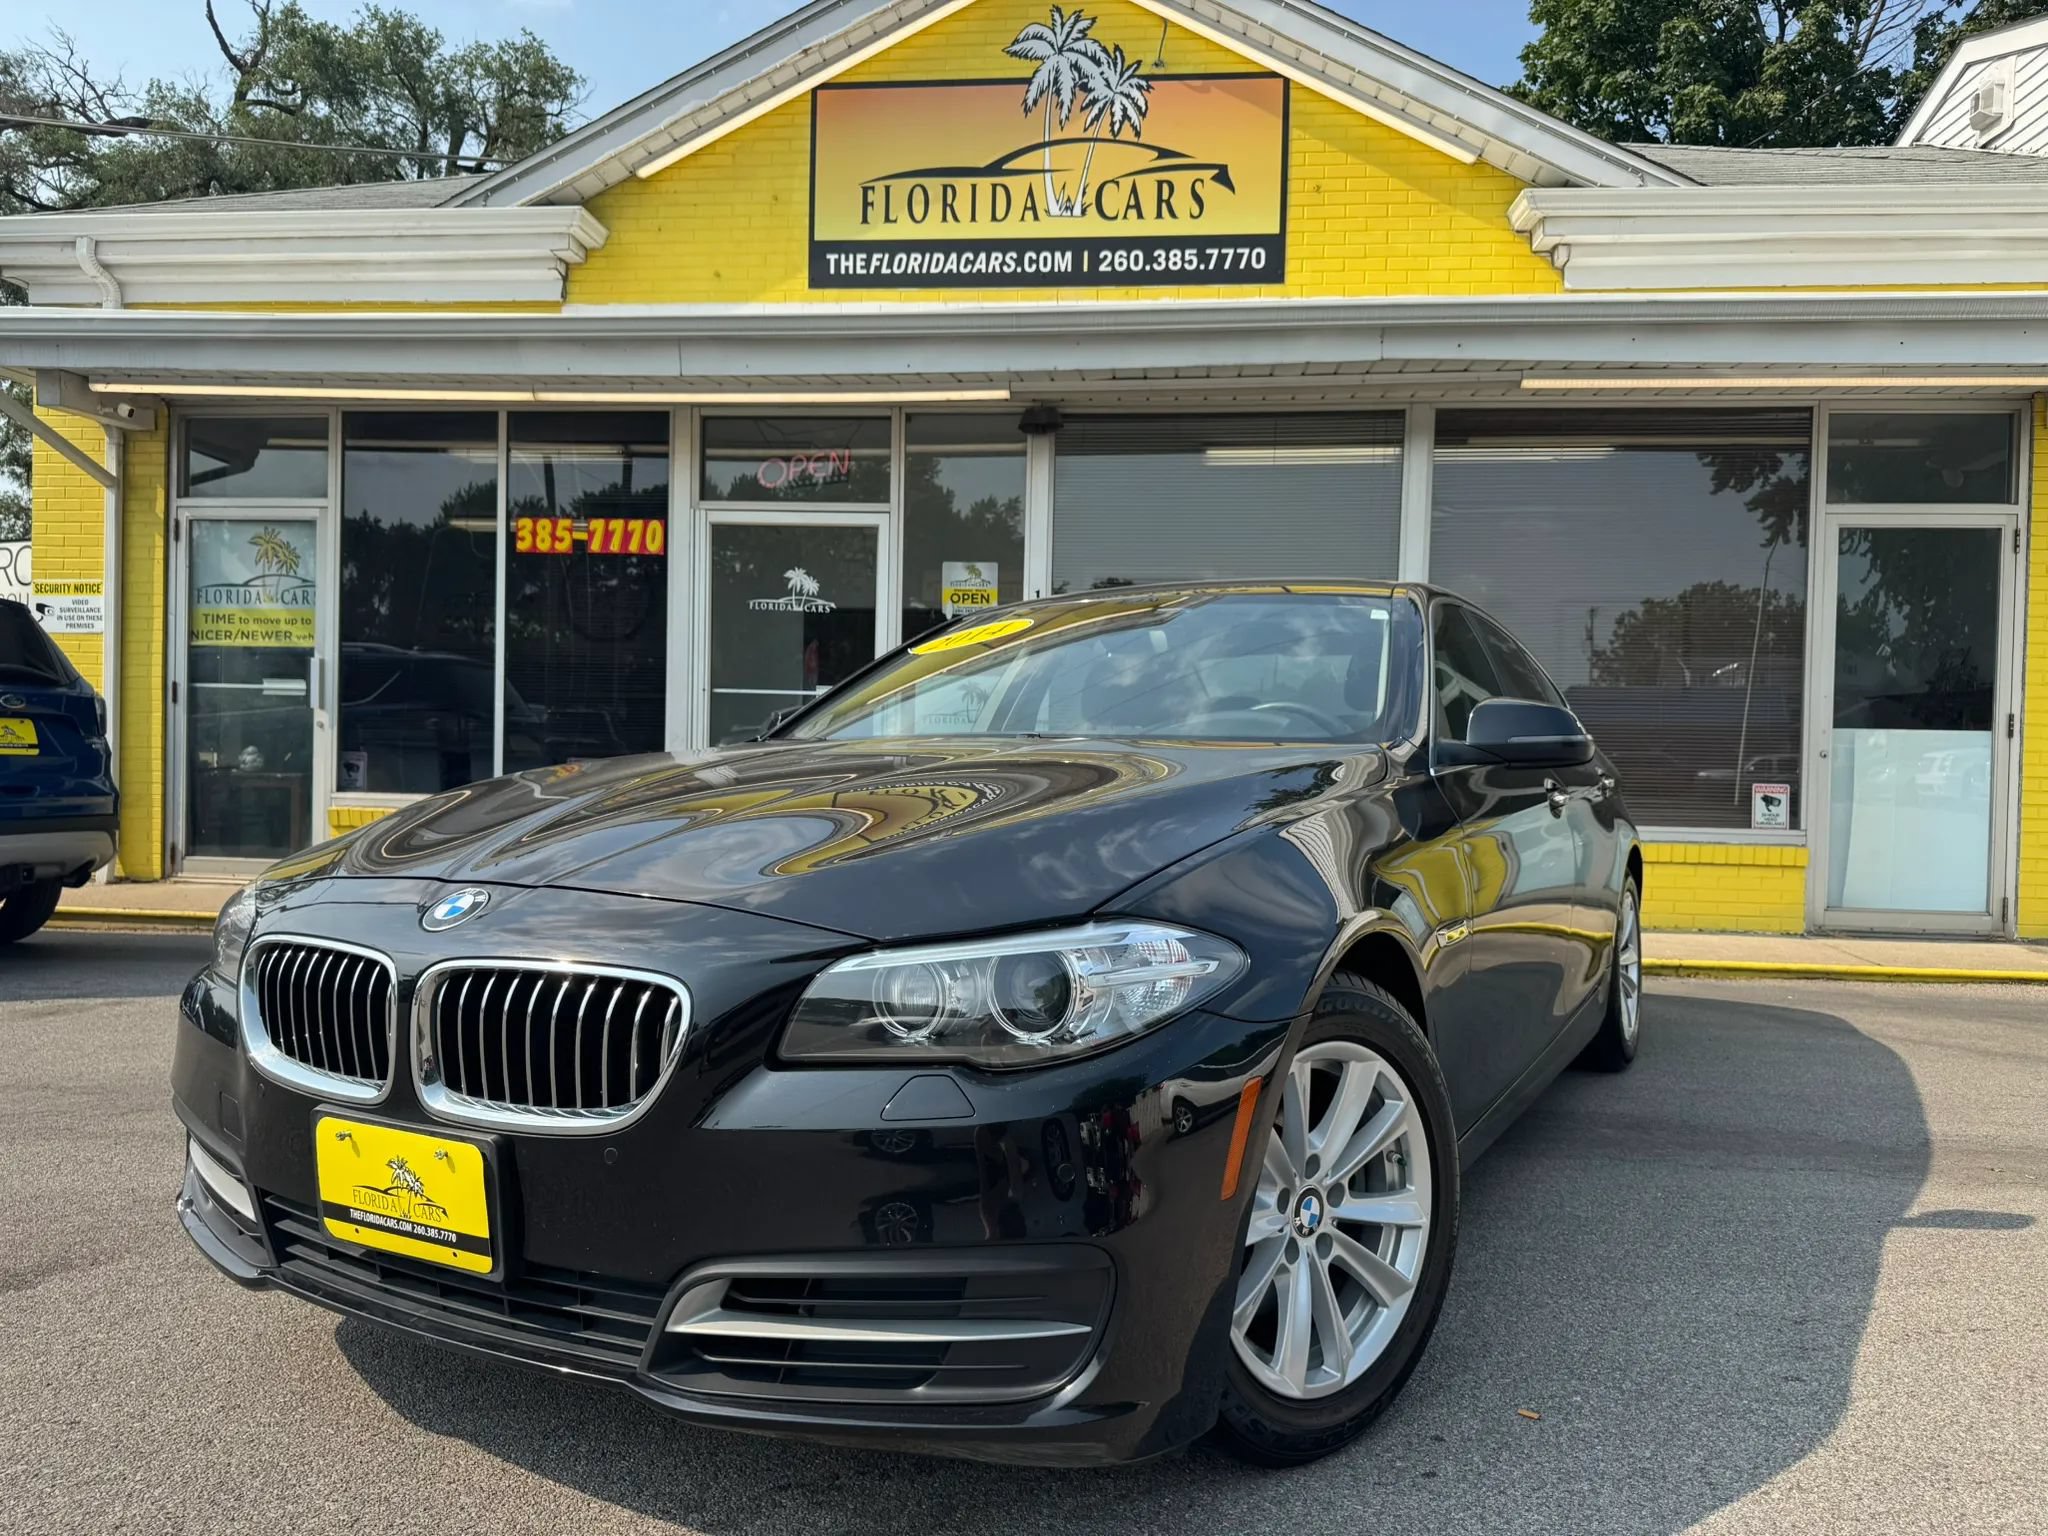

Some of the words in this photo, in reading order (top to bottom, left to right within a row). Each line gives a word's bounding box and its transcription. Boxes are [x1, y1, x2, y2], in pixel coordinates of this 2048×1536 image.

[860, 182, 1040, 225] FLORIDA
[1094, 178, 1206, 222] CARS
[826, 249, 1073, 276] THEFLORIDACARS.COM
[1098, 247, 1266, 273] 260.385.7770
[757, 449, 851, 489] OPEN
[516, 517, 664, 554] 385-7770
[34, 583, 72, 594] SECURITY
[74, 583, 102, 594] NOTICE
[196, 588, 262, 605] FLORIDA
[281, 589, 316, 605] CAR
[950, 592, 990, 605] OPEN
[749, 600, 792, 612] FLORIDA
[804, 603, 831, 614] CARS
[202, 613, 236, 625] TIME
[239, 615, 250, 625] to
[253, 616, 281, 625] move
[285, 616, 298, 627] up
[301, 615, 312, 625] to
[191, 628, 293, 642] NICER/NEWER
[352, 1188, 398, 1214] FLORIDA
[414, 1204, 442, 1223] CARS
[349, 1208, 413, 1233] THEFLORIDACARS.COM
[413, 1224, 457, 1243] 260.385.7770
